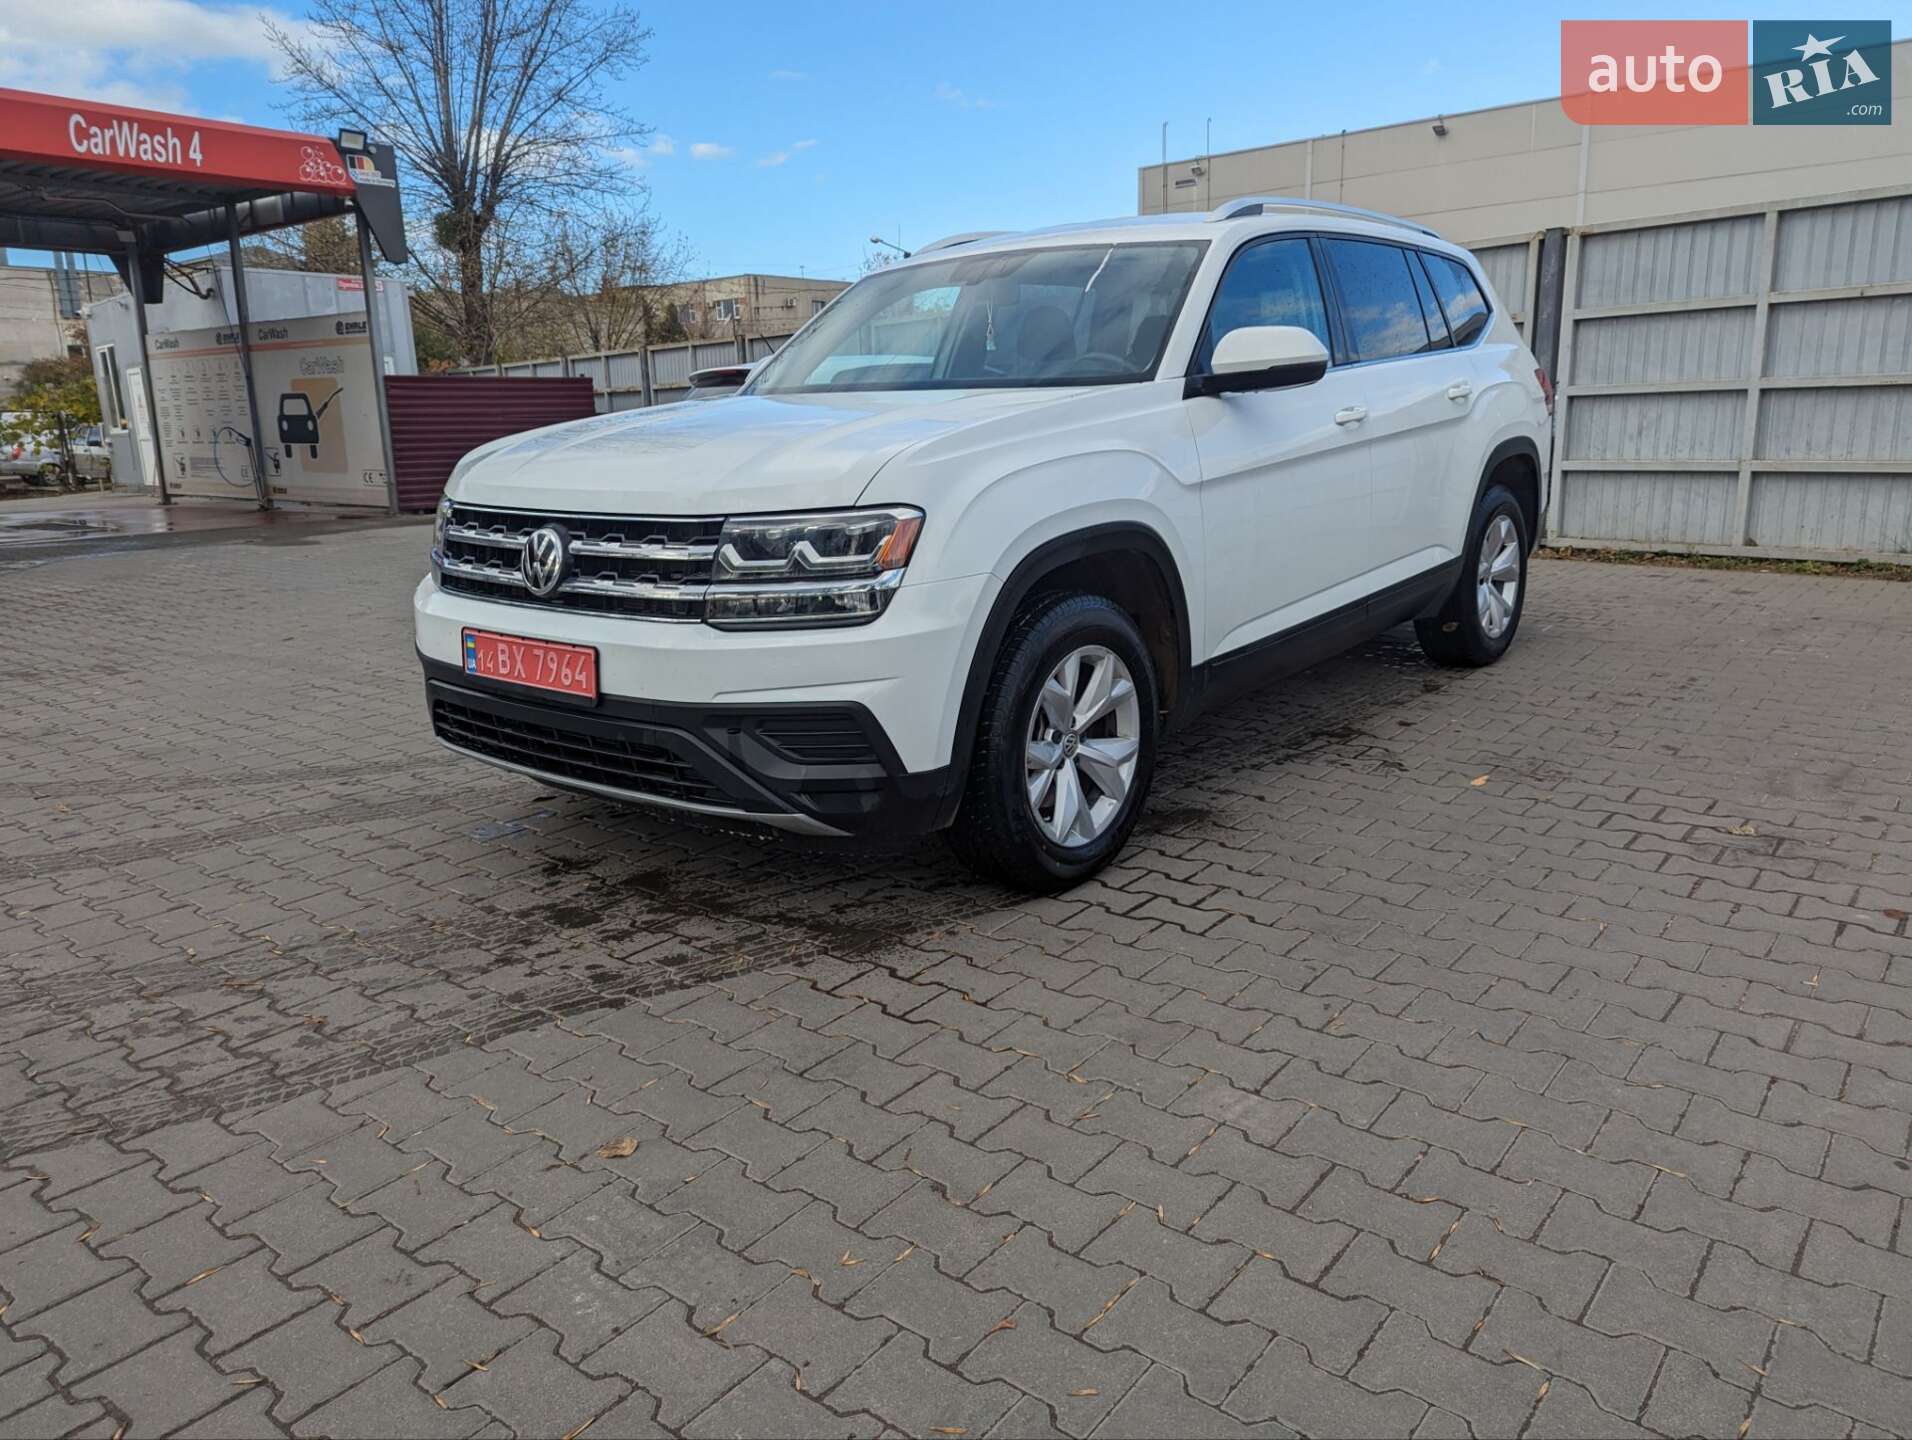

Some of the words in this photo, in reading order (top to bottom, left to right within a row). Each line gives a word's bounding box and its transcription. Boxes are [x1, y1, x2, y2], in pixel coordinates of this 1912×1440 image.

[68, 113, 182, 165] CarWash
[189, 131, 203, 167] 4
[258, 327, 288, 340] CarWash
[532, 649, 587, 689] 7964
